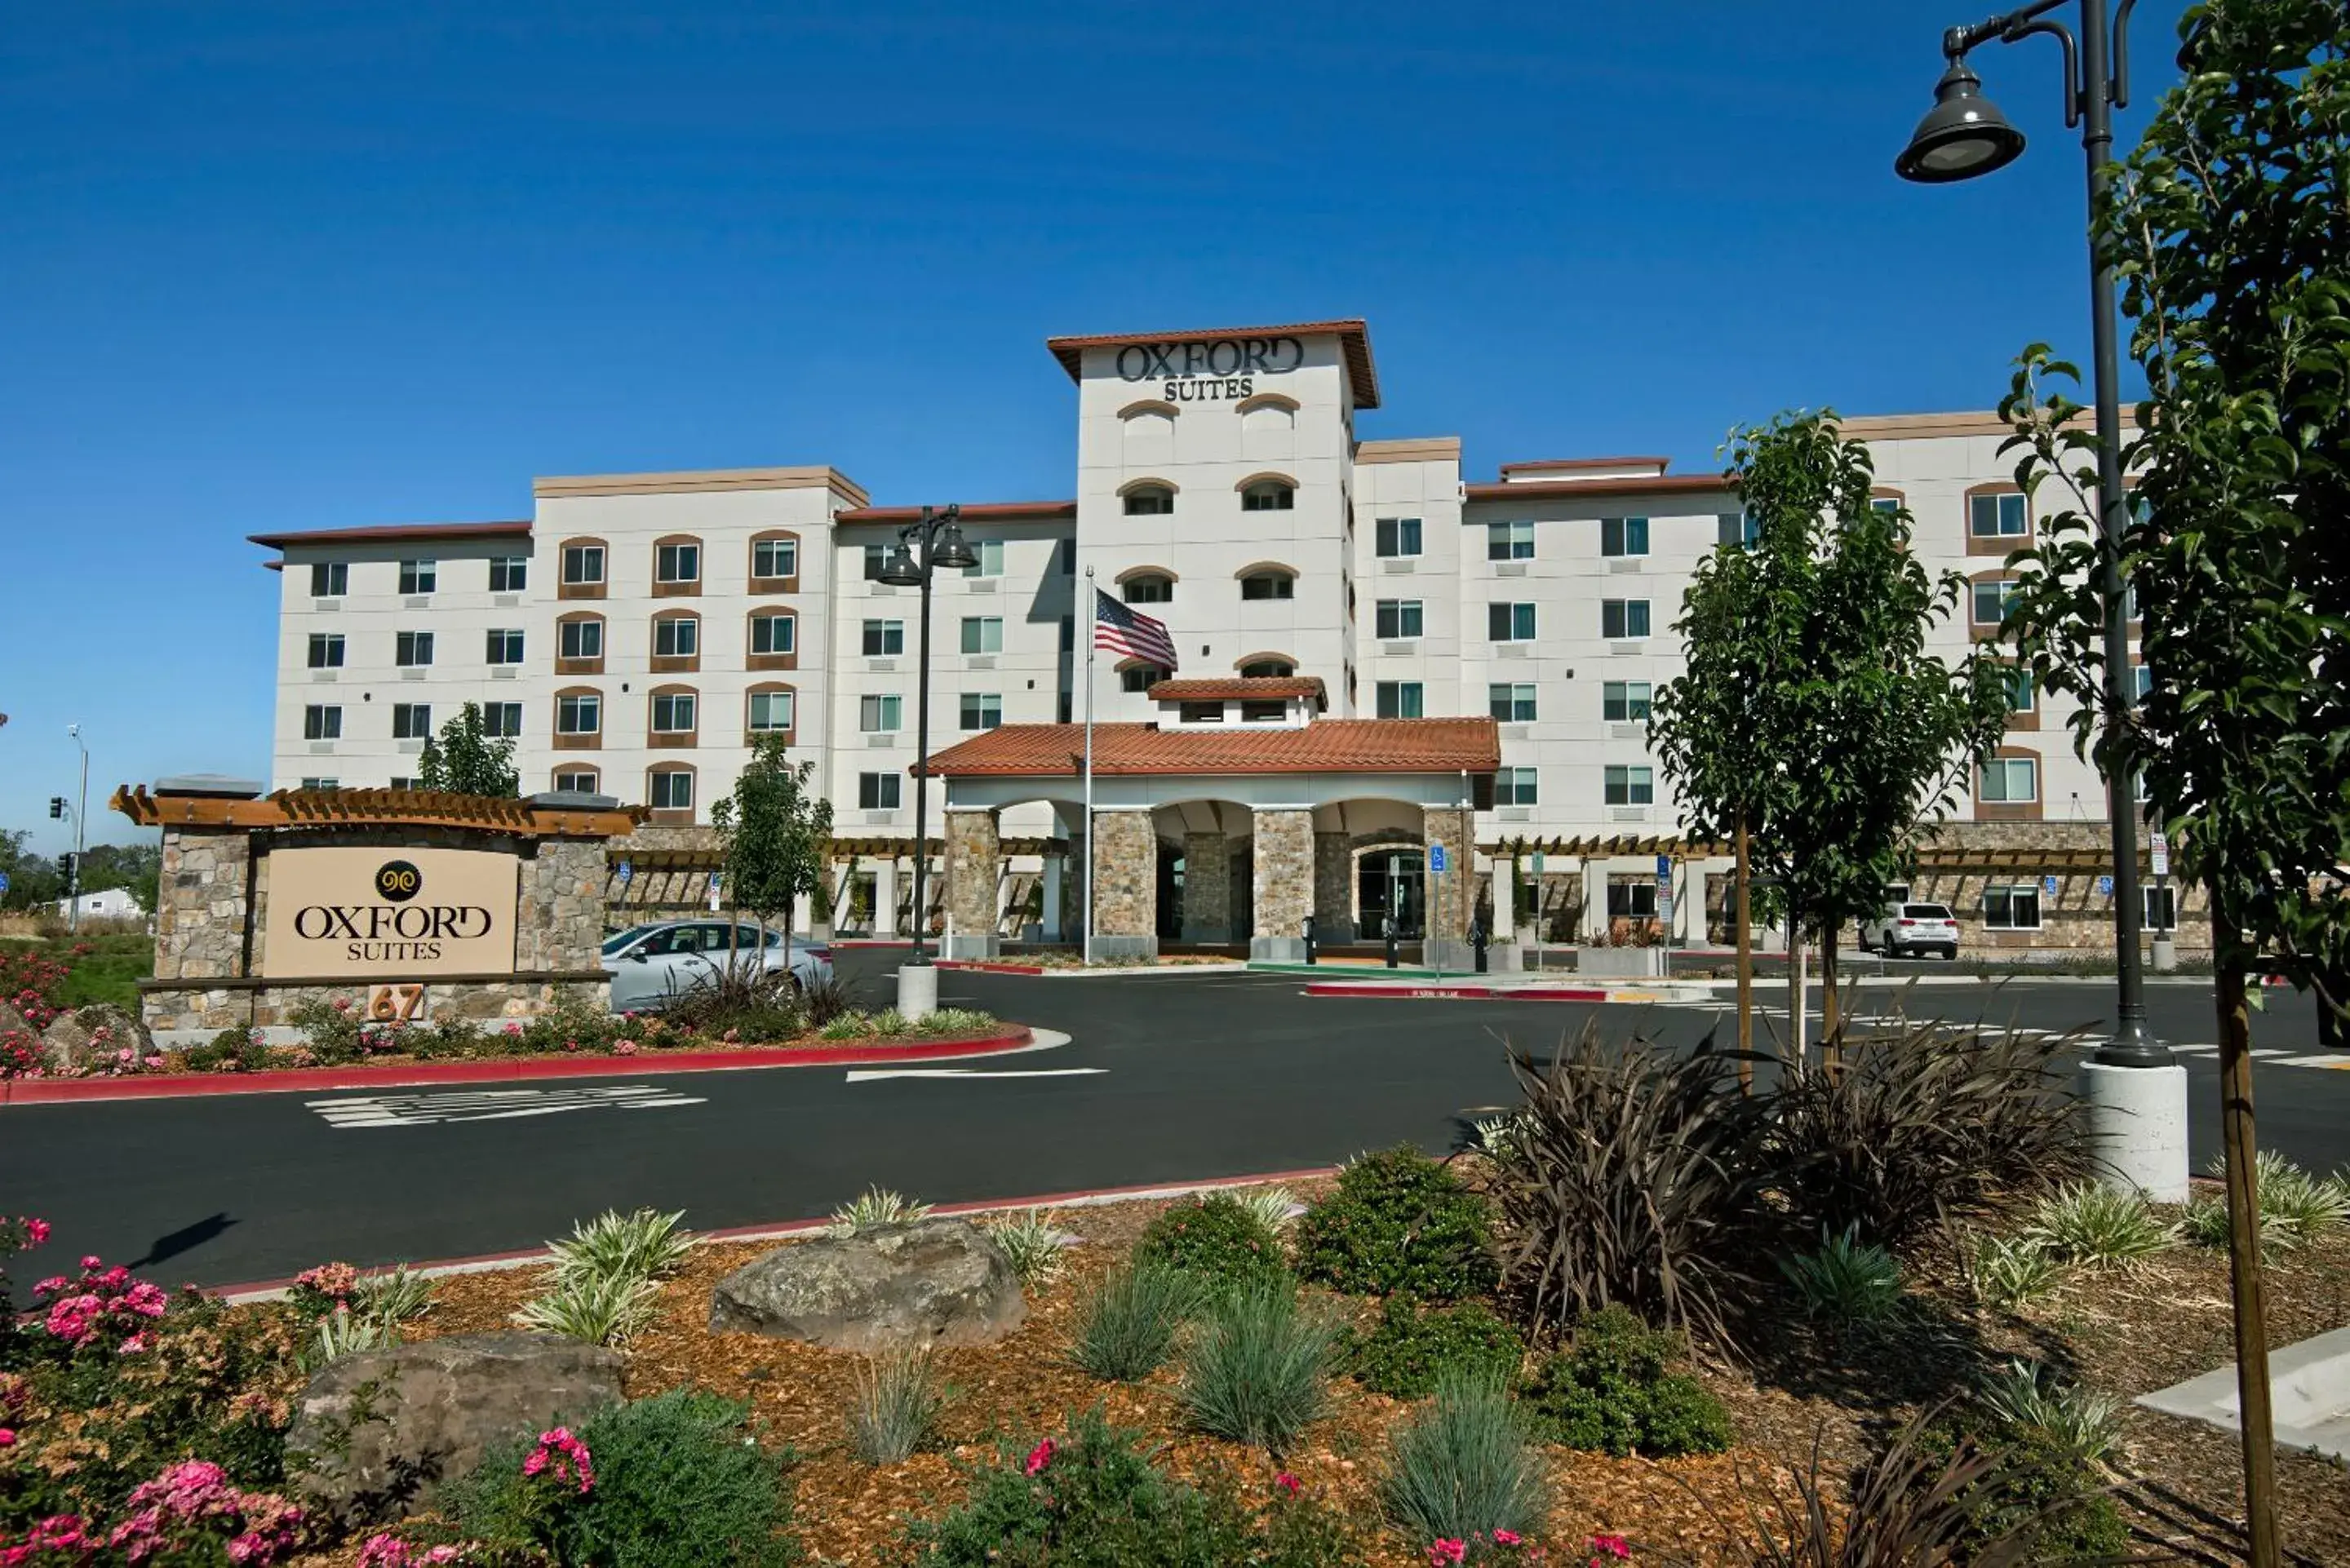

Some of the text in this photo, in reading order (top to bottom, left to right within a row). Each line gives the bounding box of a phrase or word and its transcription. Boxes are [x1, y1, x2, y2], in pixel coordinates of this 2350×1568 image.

[1116, 338, 1304, 382] OXFORD
[1164, 378, 1253, 401] SUITES
[294, 906, 492, 939] OXFORD
[347, 942, 441, 960] SUITES
[371, 986, 422, 1020] 67
